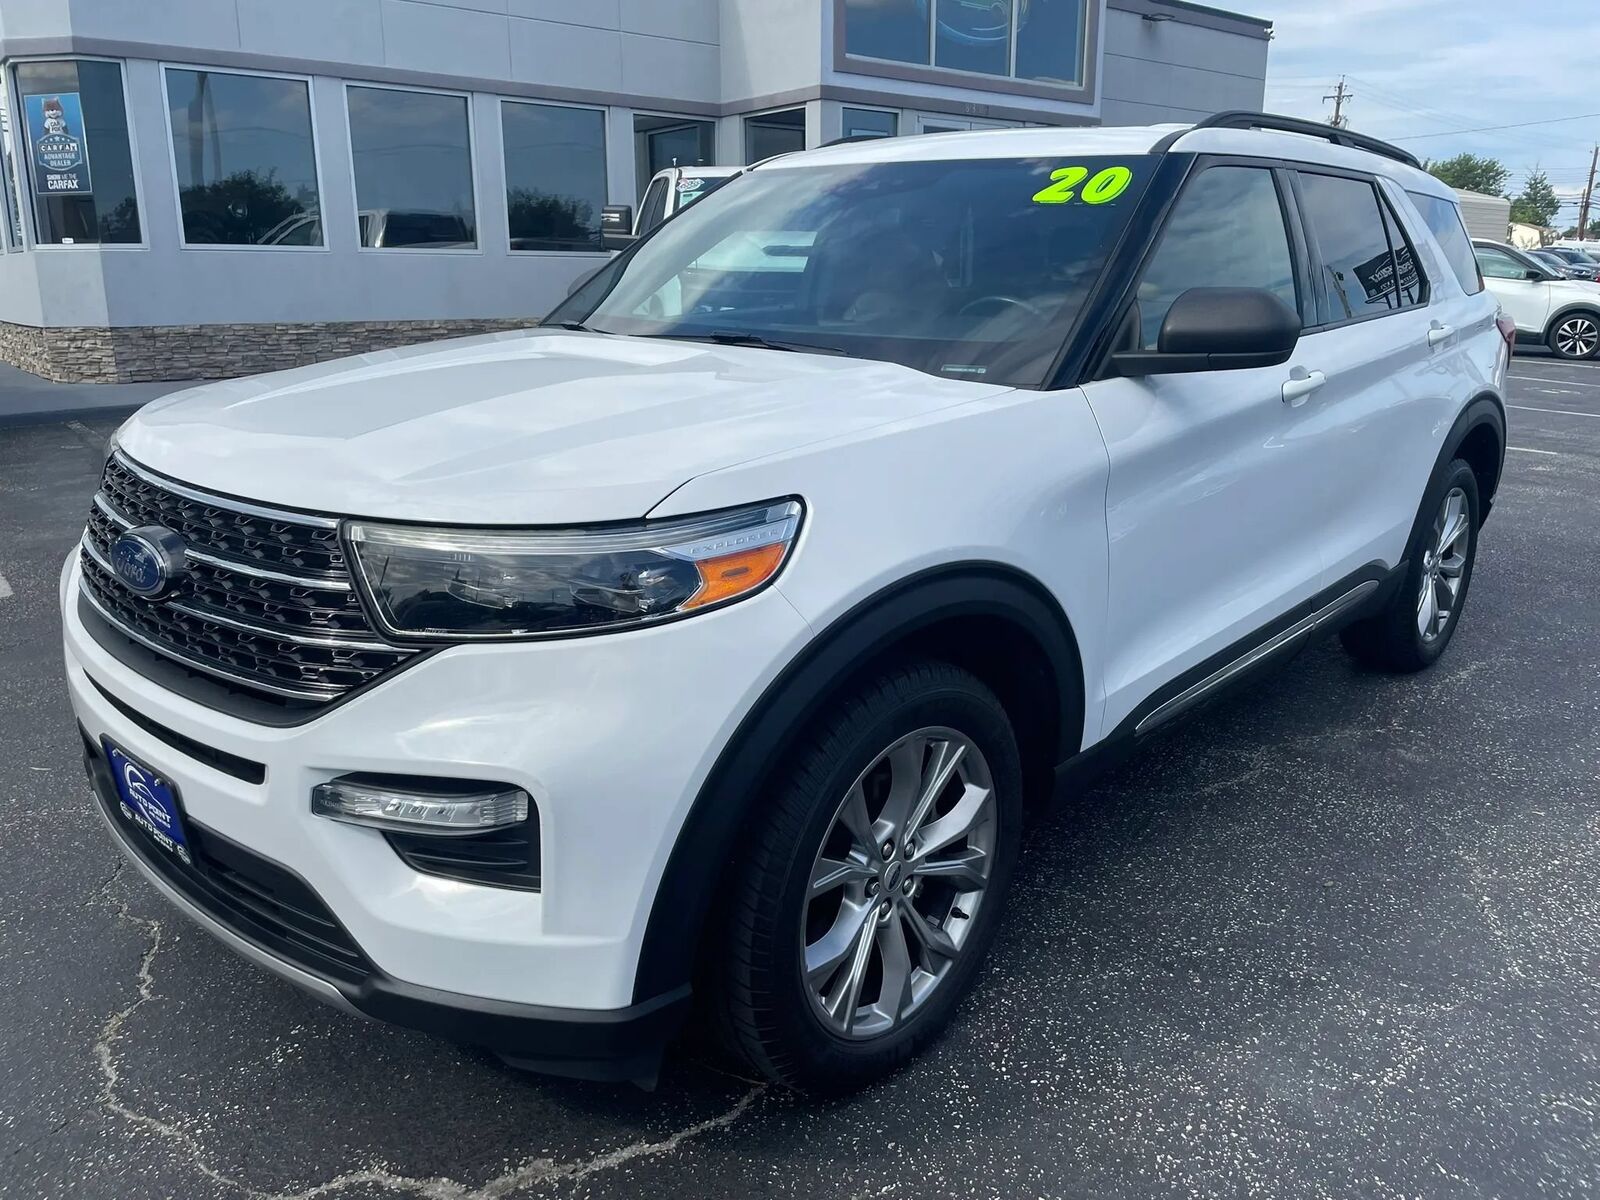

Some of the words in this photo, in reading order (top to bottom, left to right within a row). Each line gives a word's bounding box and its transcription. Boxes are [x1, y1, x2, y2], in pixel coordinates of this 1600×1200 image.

[48, 180, 79, 190] CARFAX
[1032, 166, 1133, 205] 20
[690, 529, 779, 555] EXPLORER
[129, 788, 148, 807] AUTO
[148, 802, 171, 823] POINT
[135, 814, 153, 832] AUTO
[153, 827, 173, 847] POINT
